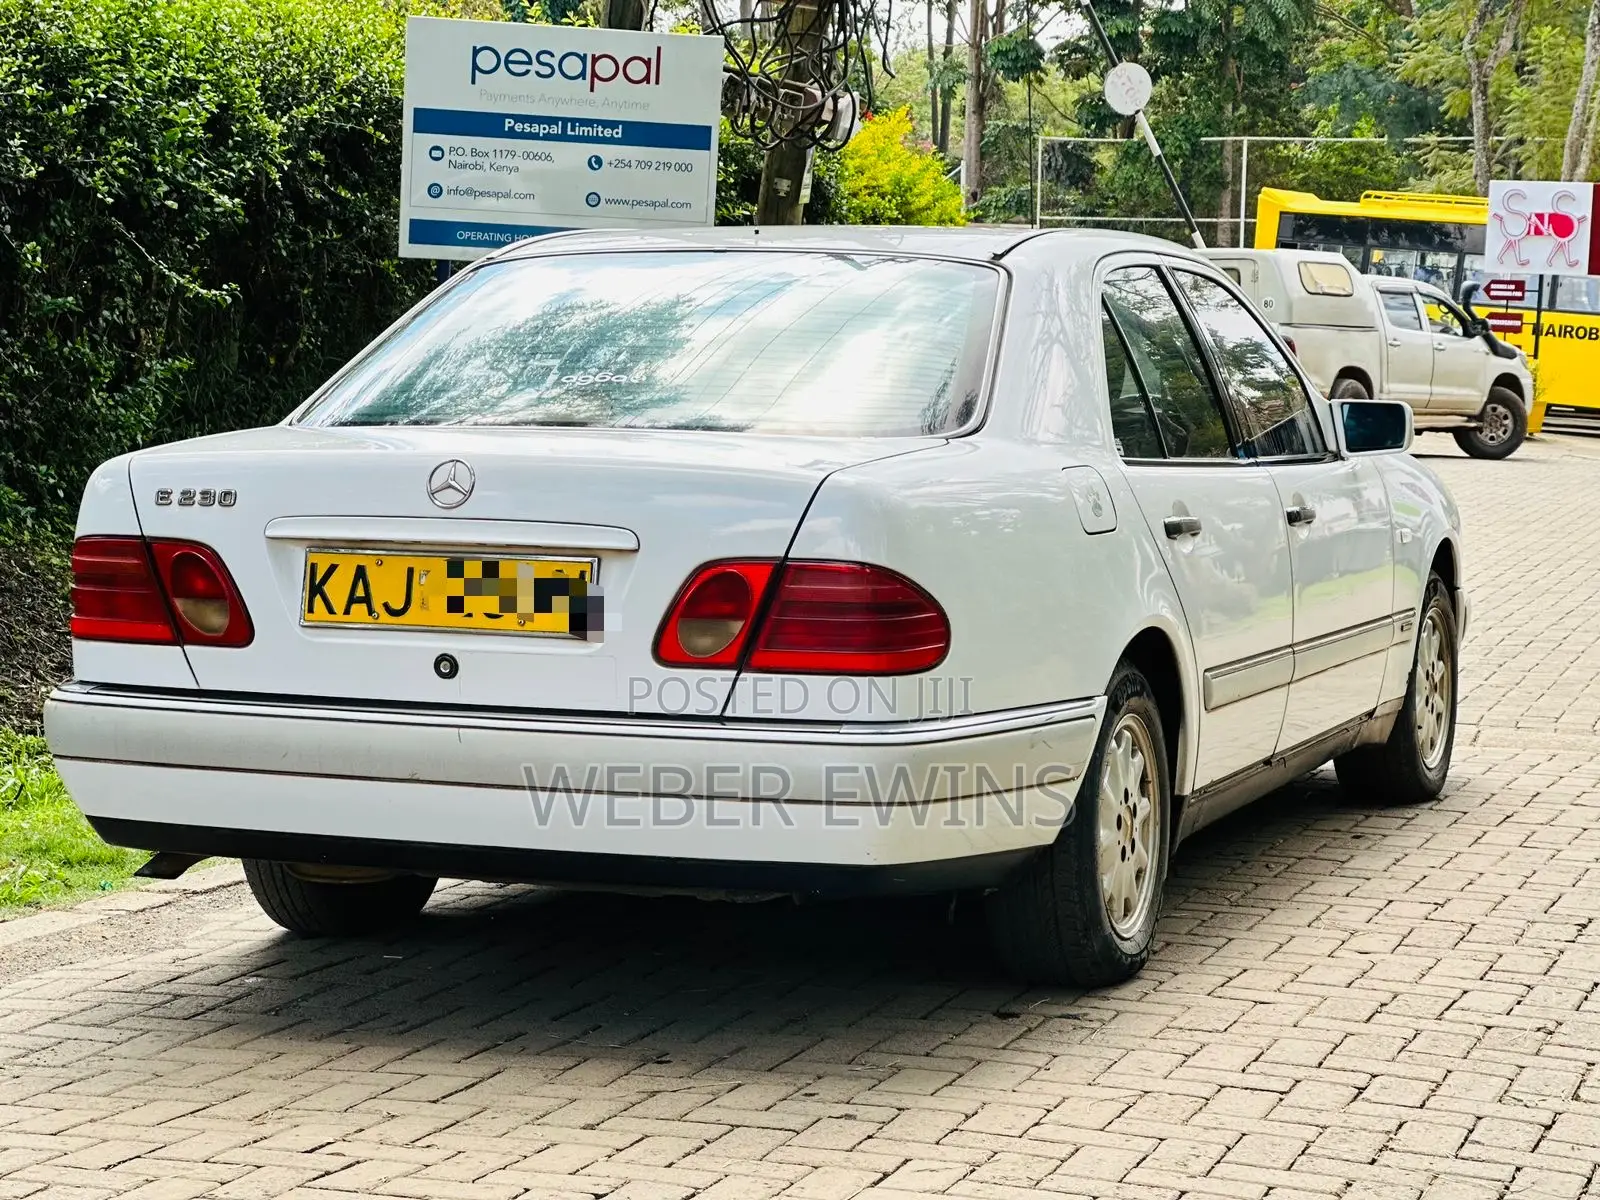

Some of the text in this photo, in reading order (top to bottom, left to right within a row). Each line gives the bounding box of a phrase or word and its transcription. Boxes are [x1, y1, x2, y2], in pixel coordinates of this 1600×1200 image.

[471, 46, 661, 92] pesapal
[480, 88, 650, 112] Payments Anywhere, Anytime
[504, 118, 623, 138] Pesapal Limited
[448, 146, 468, 157] P.O.
[470, 147, 490, 159] Box
[448, 159, 519, 175] Nairobi, Kenya
[607, 158, 693, 173] +254 709 219 000
[446, 185, 535, 201] info@pesapal.com
[604, 197, 692, 211] www.pesapal.com
[456, 230, 535, 243] OPERATING HO
[1263, 299, 1274, 309] 80
[155, 487, 237, 507] E 230
[307, 561, 415, 618] KAJ
